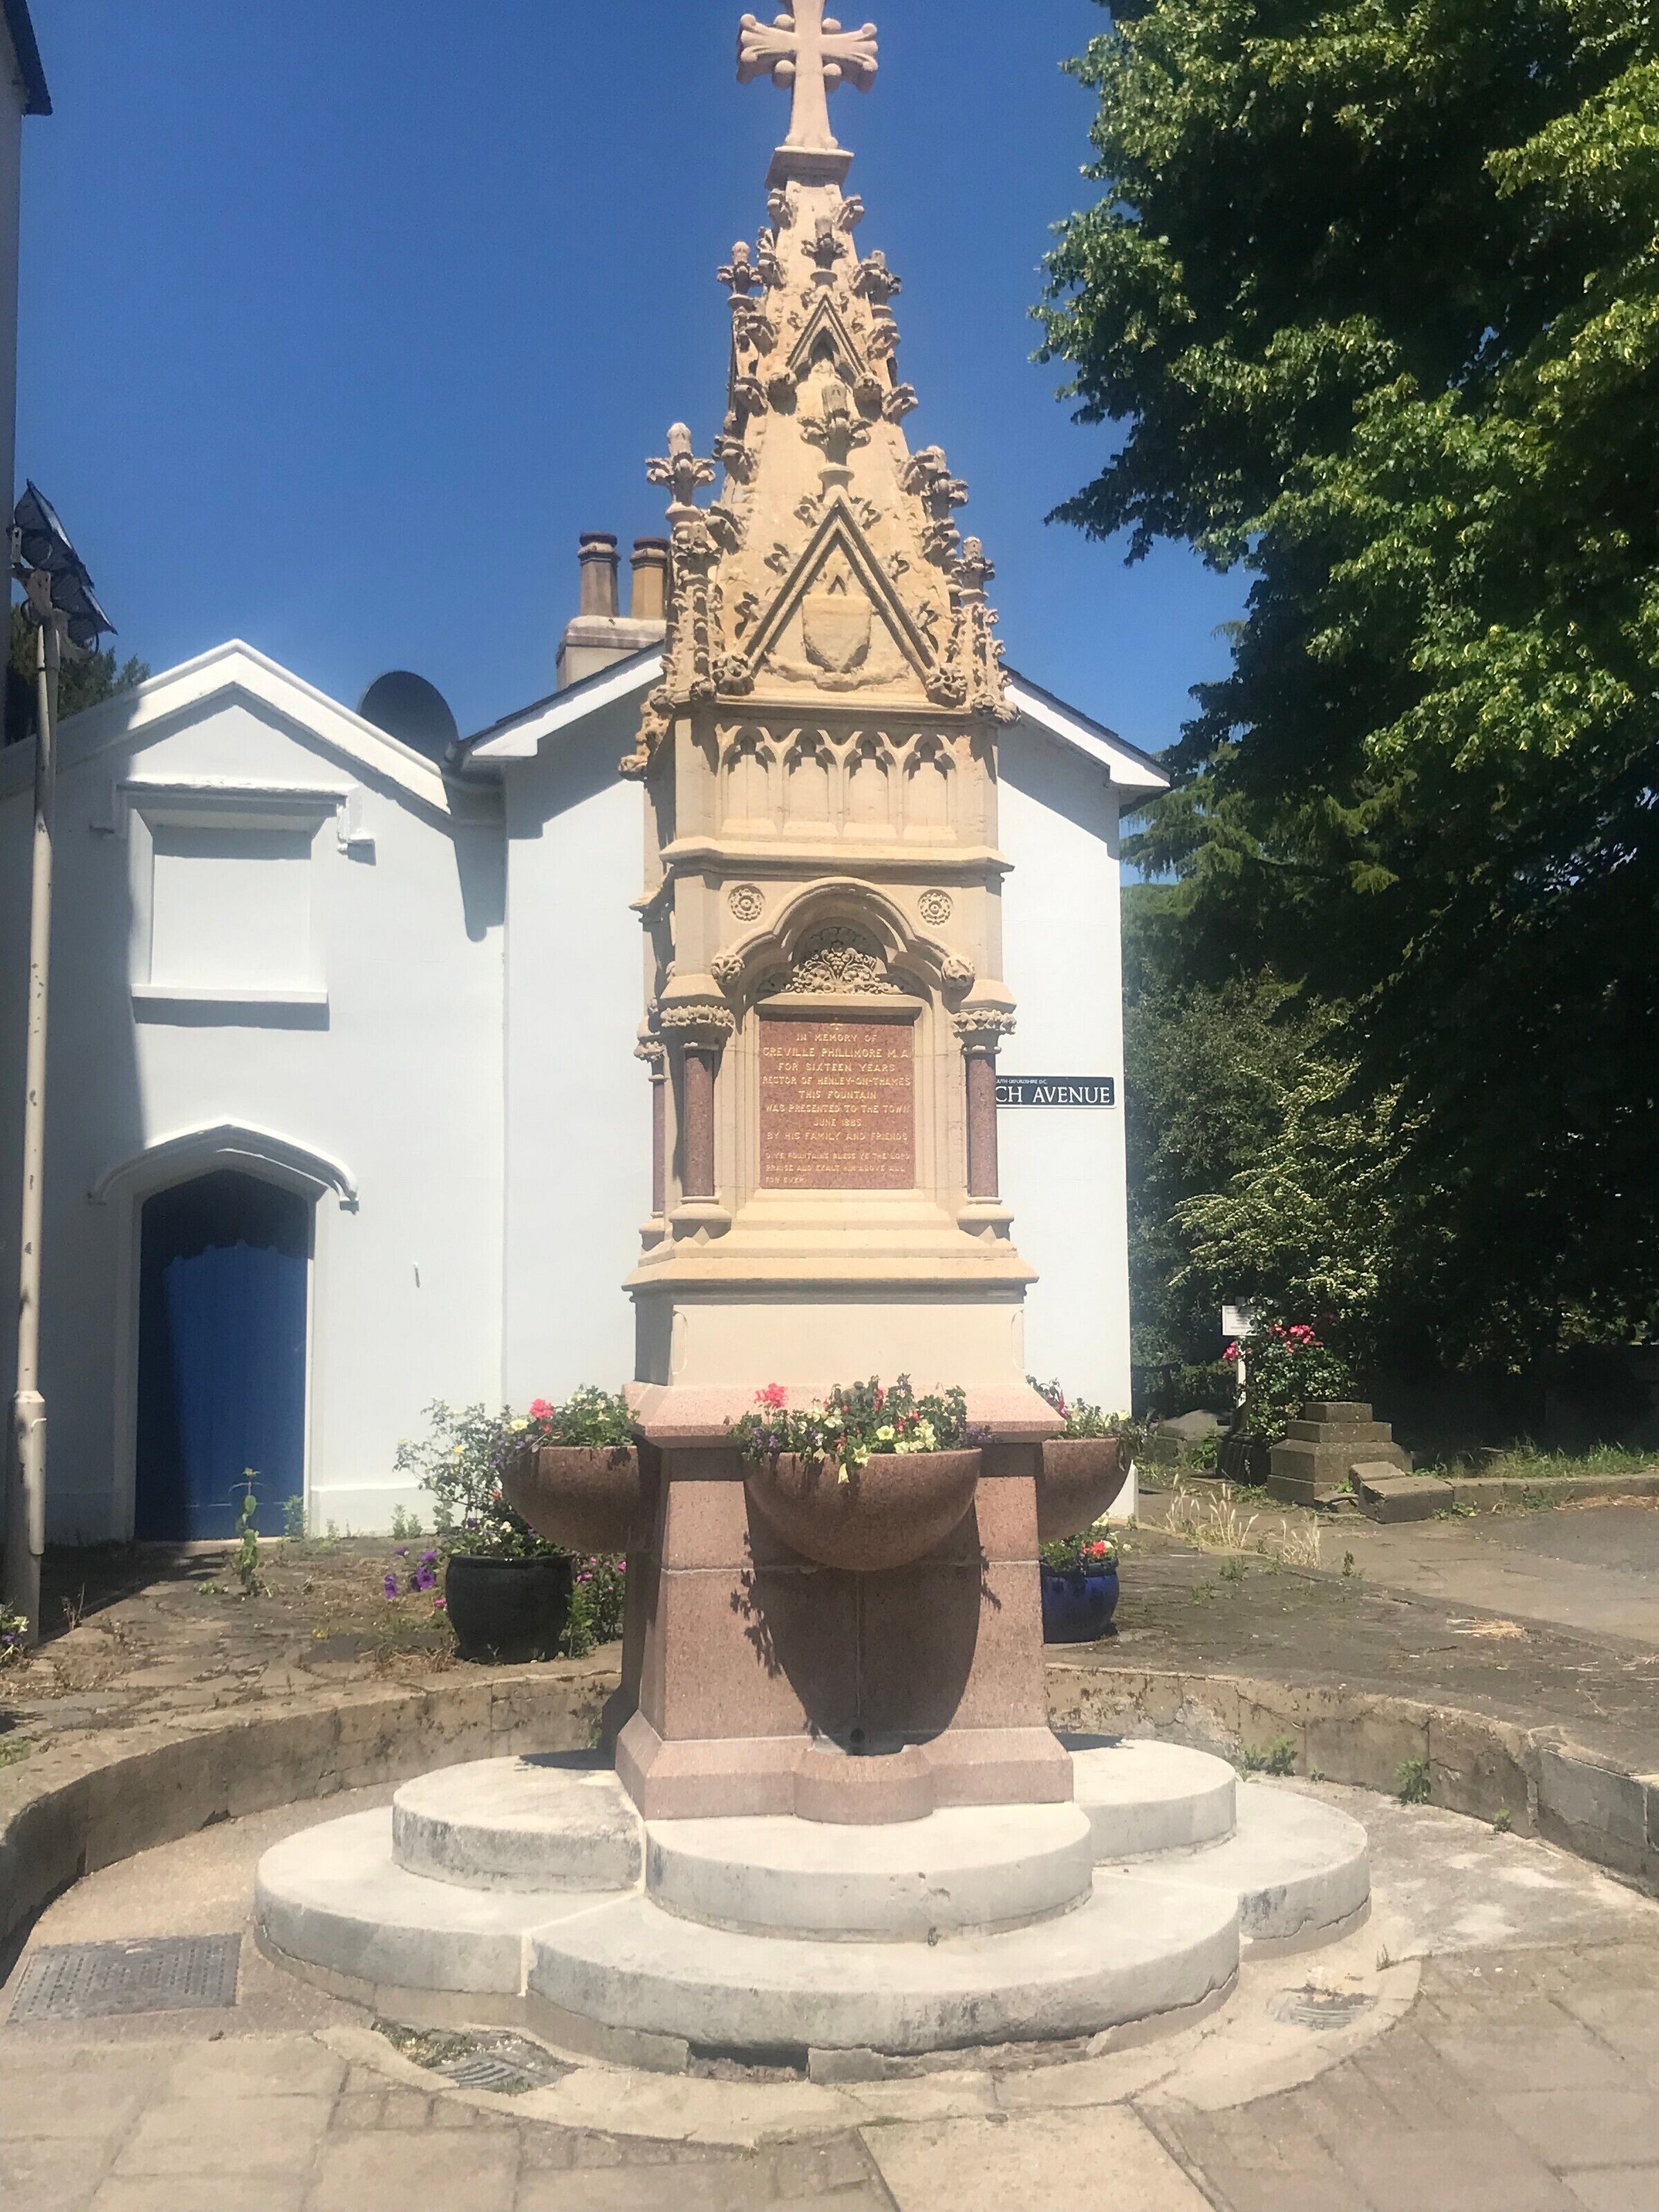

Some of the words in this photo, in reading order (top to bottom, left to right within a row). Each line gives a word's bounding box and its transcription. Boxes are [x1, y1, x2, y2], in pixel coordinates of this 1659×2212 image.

[796, 1033, 807, 1042] IN
[815, 1033, 857, 1042] MEMORY
[865, 1034, 877, 1042] OF
[763, 1047, 816, 1057] GREVILLE
[821, 1047, 882, 1058] PHILLIMORE
[778, 1062, 798, 1071] FOR
[806, 1062, 852, 1072] SIXTEEN
[859, 1063, 895, 1072] YEARS
[762, 1076, 797, 1085] RECTOR
[801, 1076, 812, 1085] OF
[798, 1090, 821, 1099] THIS
[827, 1090, 877, 1100] FOUNTAIN
[995, 1086, 1023, 1103] CH
[1032, 1087, 1110, 1103] AVENUE
[766, 1104, 785, 1113] WAS
[789, 1104, 840, 1114] PRESENTED
[843, 1105, 857, 1114] TO
[861, 1105, 879, 1114] THE
[814, 1118, 836, 1127] JUNE
[767, 1132, 779, 1141] BY
[785, 1132, 800, 1141] HIS
[805, 1132, 841, 1141] FAMILY
[845, 1132, 865, 1141] AND
[870, 1132, 908, 1141] FRIENDS
